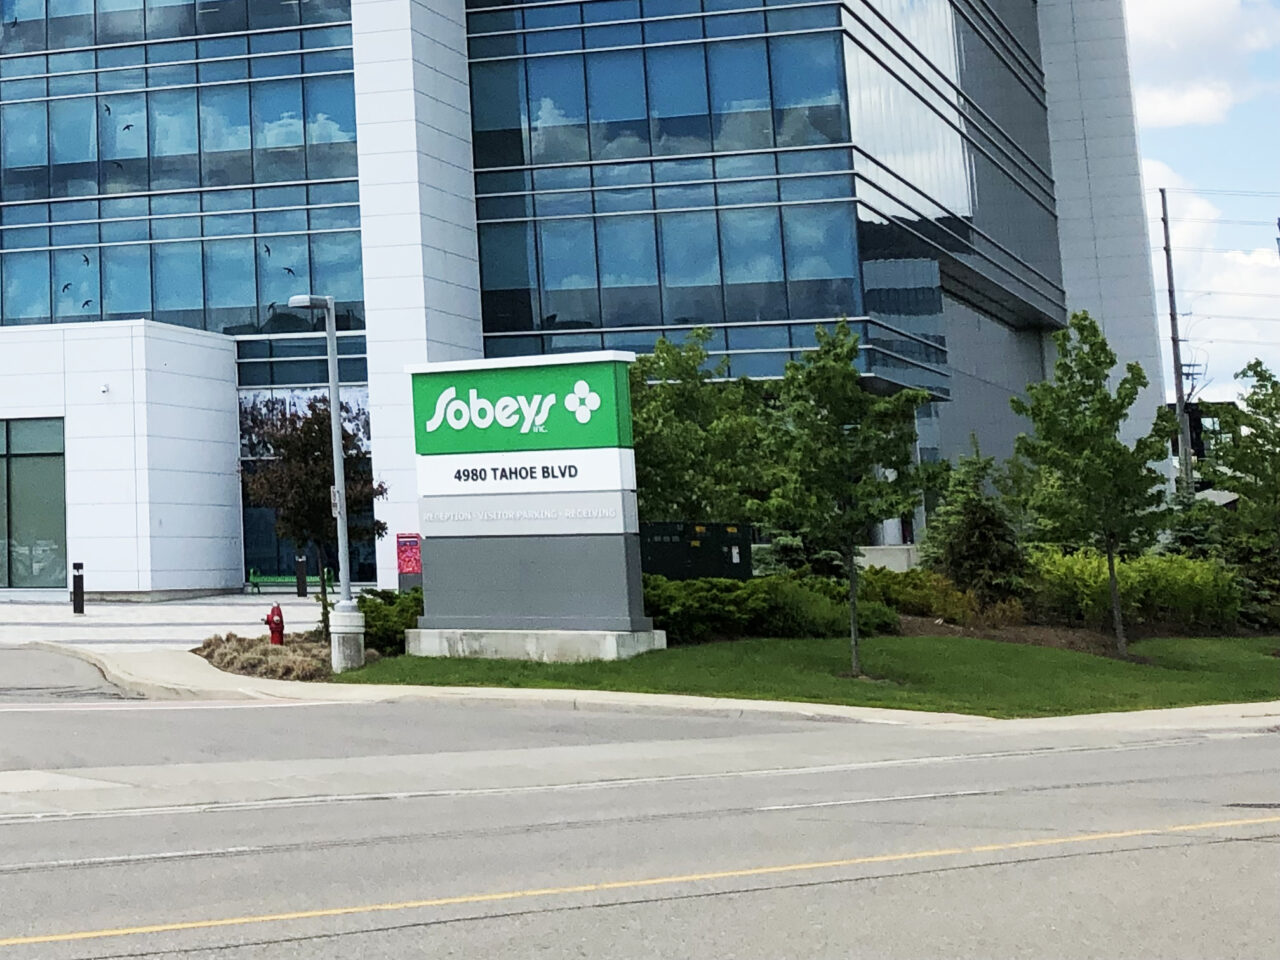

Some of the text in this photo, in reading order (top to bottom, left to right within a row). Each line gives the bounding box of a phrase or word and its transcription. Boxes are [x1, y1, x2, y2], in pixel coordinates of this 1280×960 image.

[426, 386, 556, 433] Sobeys
[454, 464, 578, 482] 4980 TAHOE BLVD
[423, 507, 616, 521] RECEPTION VISITOR PARKING RECEIVING
